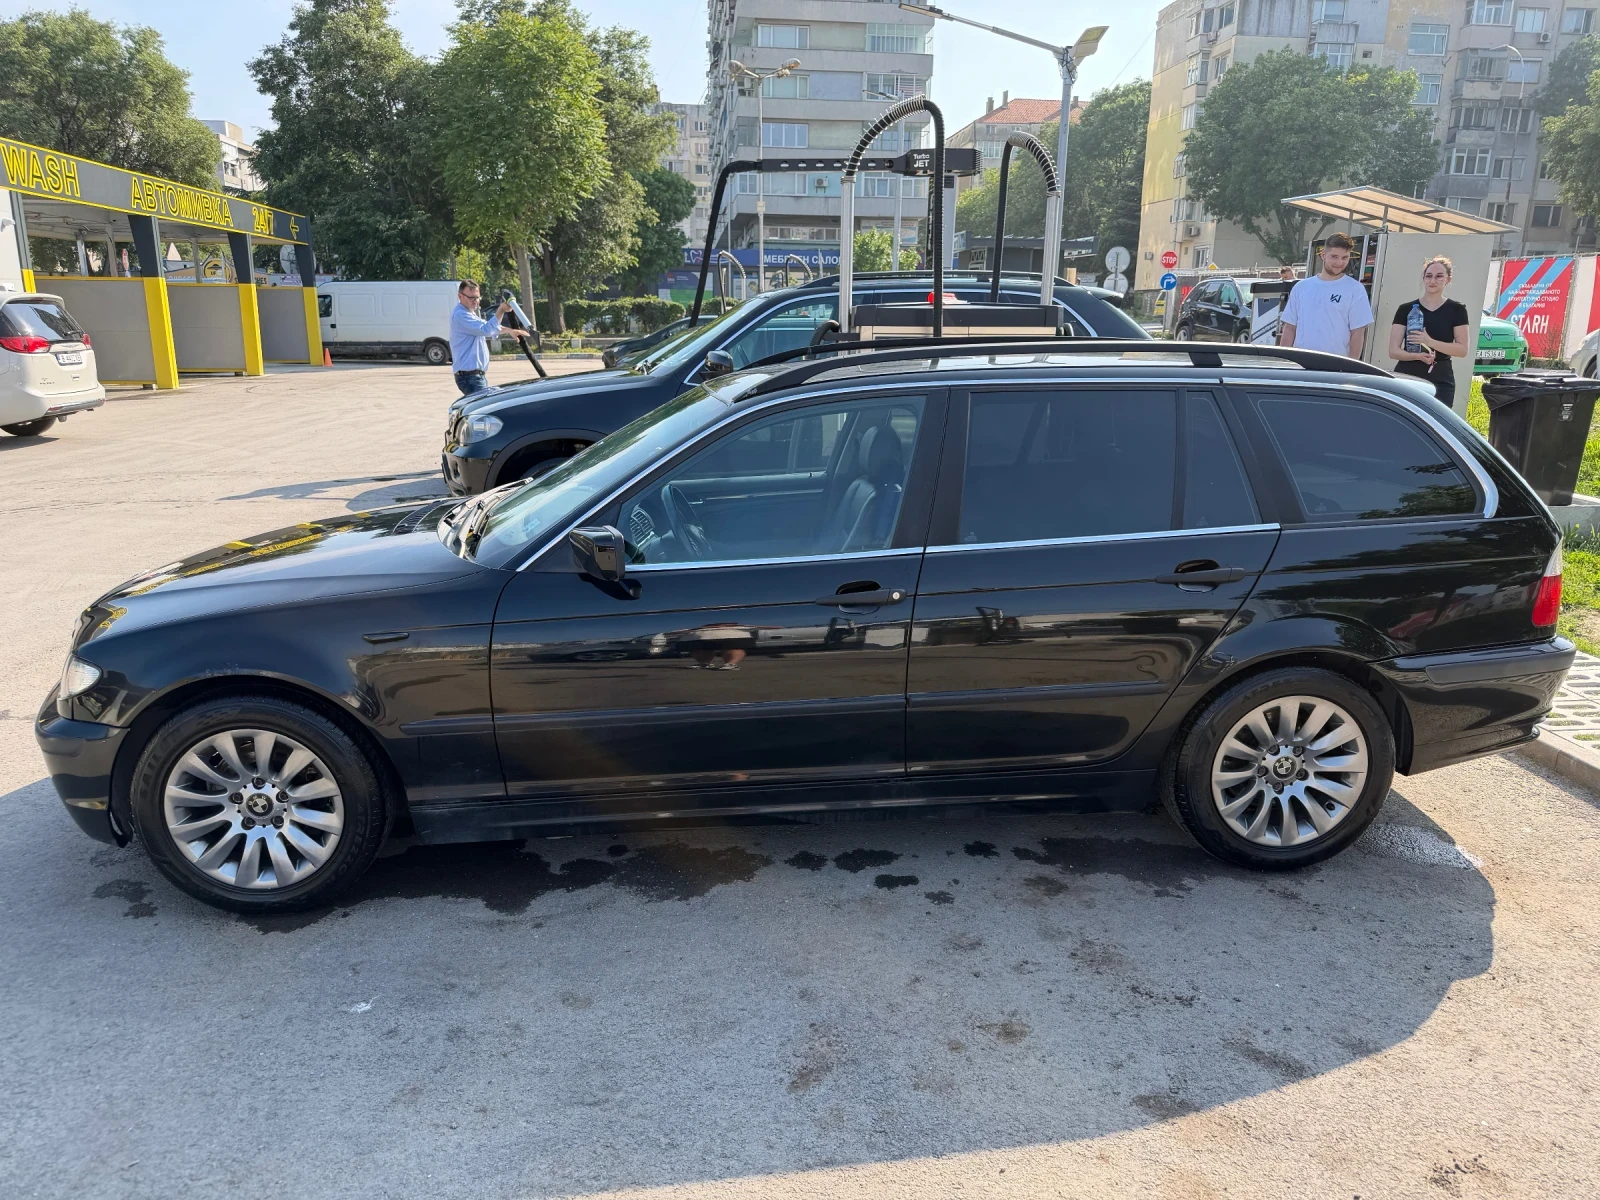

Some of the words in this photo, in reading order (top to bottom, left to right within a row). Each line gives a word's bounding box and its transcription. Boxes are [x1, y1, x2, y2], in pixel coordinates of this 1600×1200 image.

[913, 160, 930, 168] JET
[0, 143, 81, 198] WASH
[131, 177, 234, 227] АВТОМИВКА
[251, 206, 275, 235] 24/7
[811, 255, 841, 265] САЛО
[1161, 256, 1177, 264] STOP
